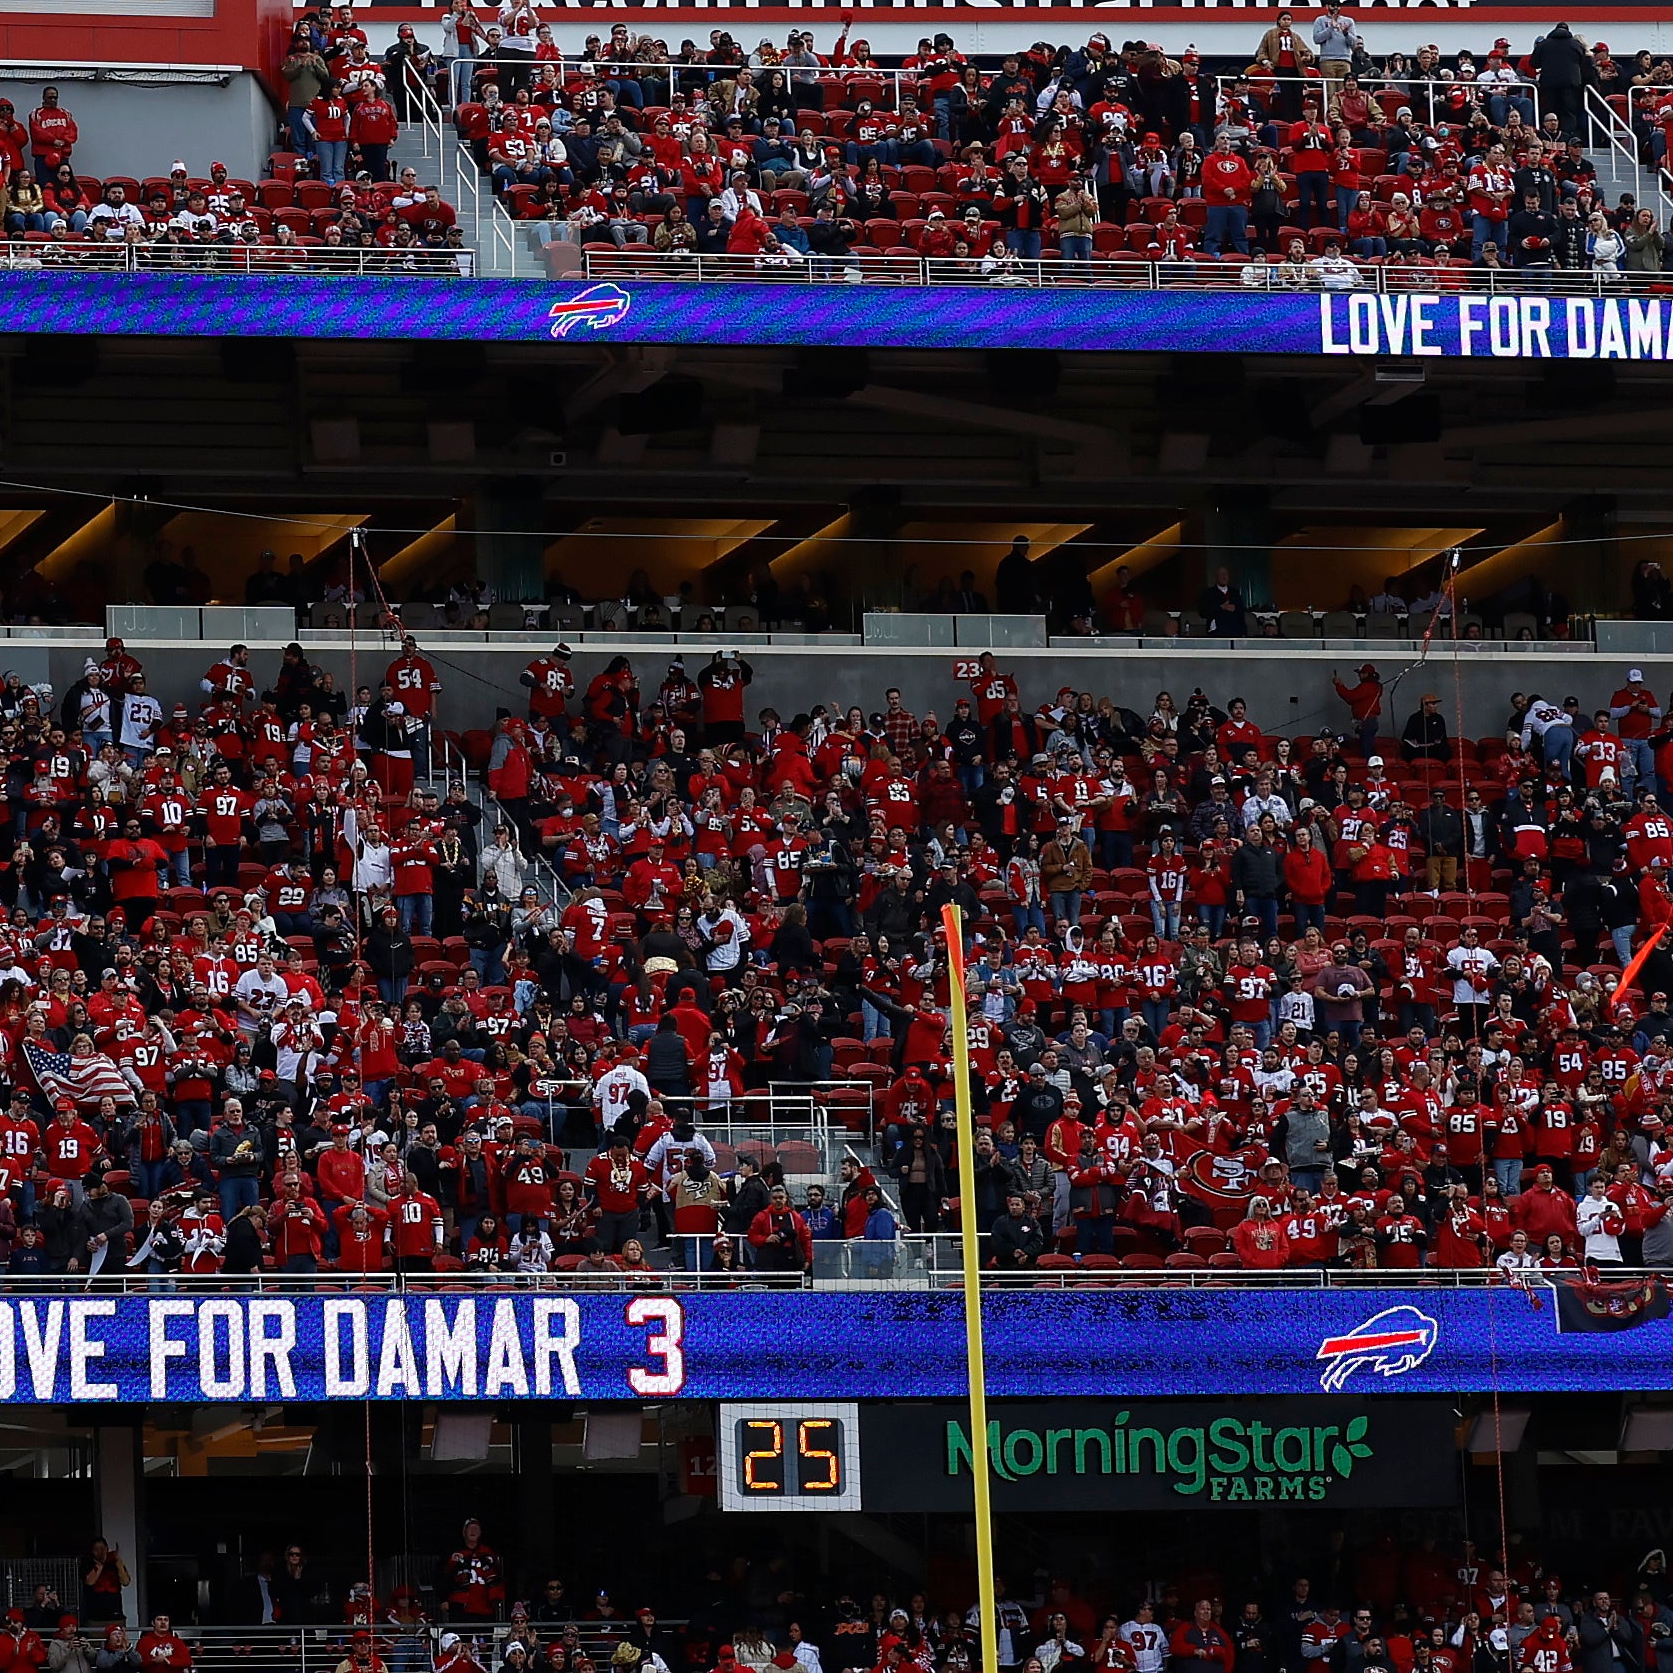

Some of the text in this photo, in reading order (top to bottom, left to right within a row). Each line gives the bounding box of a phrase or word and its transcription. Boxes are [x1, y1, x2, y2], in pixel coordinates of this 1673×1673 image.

[328, 106, 340, 118] 10
[523, 113, 532, 125] 7
[859, 127, 876, 140] 85
[505, 140, 525, 155] 53
[1412, 189, 1421, 203] 8
[1320, 293, 1443, 357] LOVE
[1459, 295, 1551, 359] FOR
[398, 668, 421, 688] 54
[958, 663, 982, 677] 23
[547, 671, 565, 689] 85
[131, 704, 152, 723] 23
[264, 724, 280, 741] 19
[1593, 741, 1615, 761] 33
[51, 756, 70, 775] 19
[1037, 786, 1047, 799] 5
[1075, 782, 1088, 799] 11
[163, 803, 182, 823] 10
[217, 796, 237, 815] 97
[708, 816, 721, 831] 85
[1645, 821, 1667, 838] 85
[777, 851, 800, 869] 85
[1161, 871, 1176, 888] 16
[280, 887, 304, 905] 29
[592, 918, 603, 940] 7
[235, 944, 257, 962] 85
[210, 971, 229, 992] 16
[1144, 966, 1166, 986] 16
[1240, 978, 1265, 999] 97
[1292, 1002, 1305, 1016] 21
[488, 1018, 510, 1033] 97
[967, 1028, 988, 1048] 29
[135, 1047, 159, 1066] 97
[1560, 1053, 1583, 1071] 54
[1603, 1061, 1626, 1078] 85
[609, 1083, 629, 1104] 97
[1451, 1114, 1475, 1132] 85
[1546, 1110, 1566, 1128] 19
[1247, 1124, 1264, 1135] 54
[6, 1131, 27, 1153] 16
[58, 1139, 78, 1158] 19
[1106, 1137, 1129, 1158] 94
[518, 1167, 544, 1184] 49
[403, 1203, 421, 1223] 10
[1287, 1219, 1314, 1238] 49
[148, 1299, 297, 1399] FOR
[324, 1297, 582, 1397] DAMAR
[625, 1295, 687, 1399] 3
[746, 1421, 837, 1489] 25
[947, 1411, 1340, 1495] MorningStar
[690, 1456, 716, 1476] 12
[1210, 1476, 1327, 1501] FARMS
[1132, 1633, 1155, 1650] 97
[1534, 1650, 1557, 1672] 42
